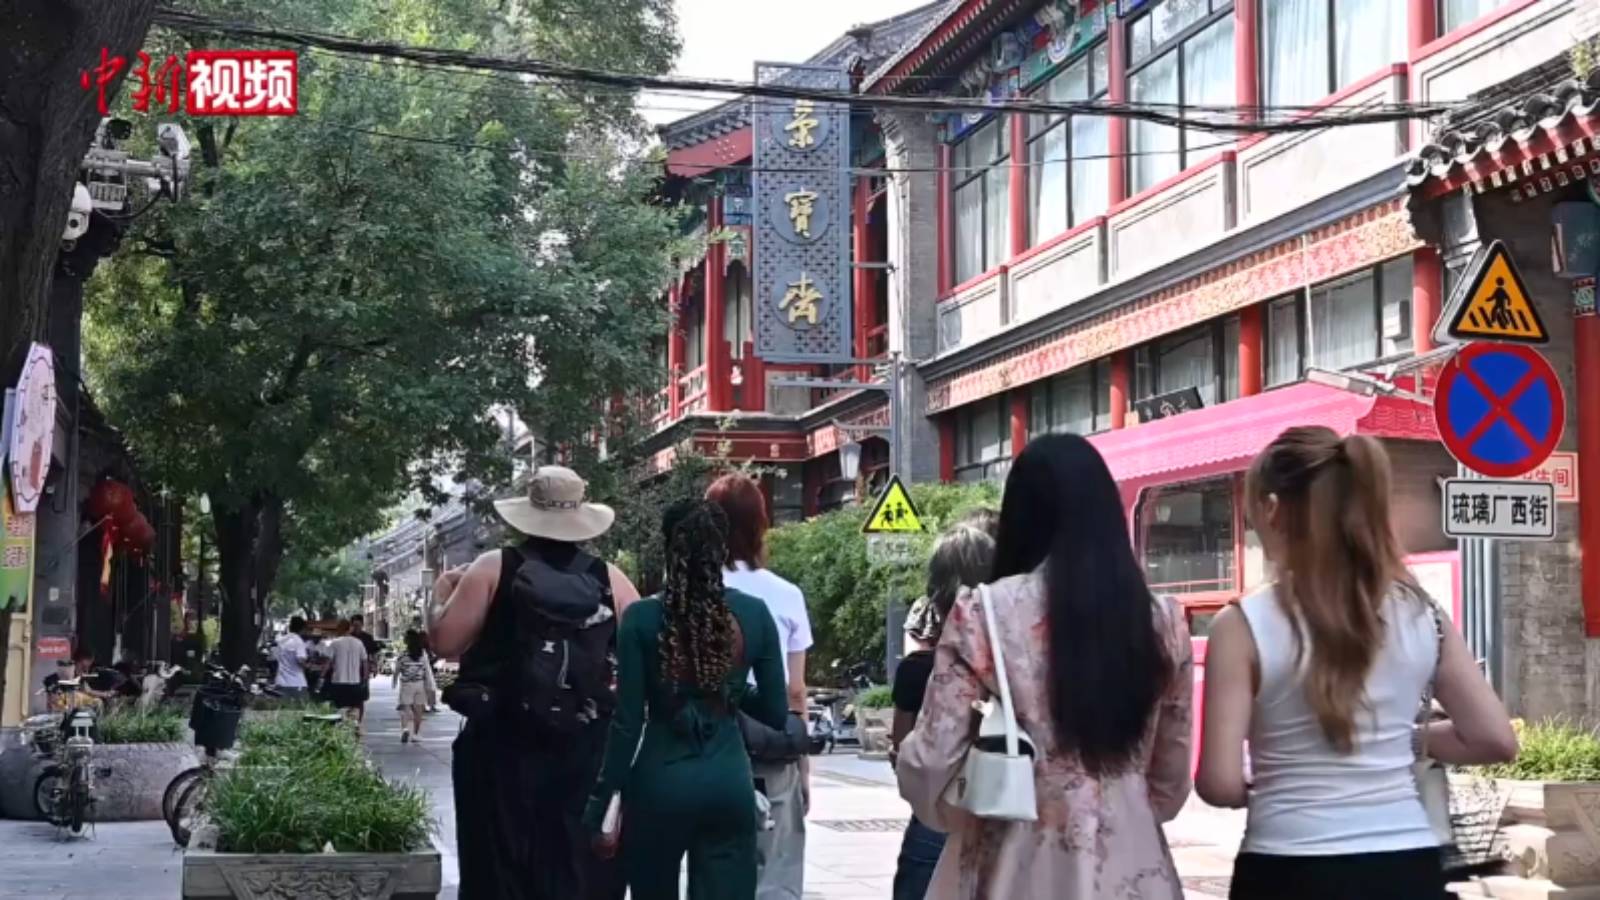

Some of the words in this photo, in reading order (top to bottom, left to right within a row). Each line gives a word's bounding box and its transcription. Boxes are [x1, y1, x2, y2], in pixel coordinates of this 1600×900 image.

[1451, 492, 1549, 527] 琉璃厂西街
